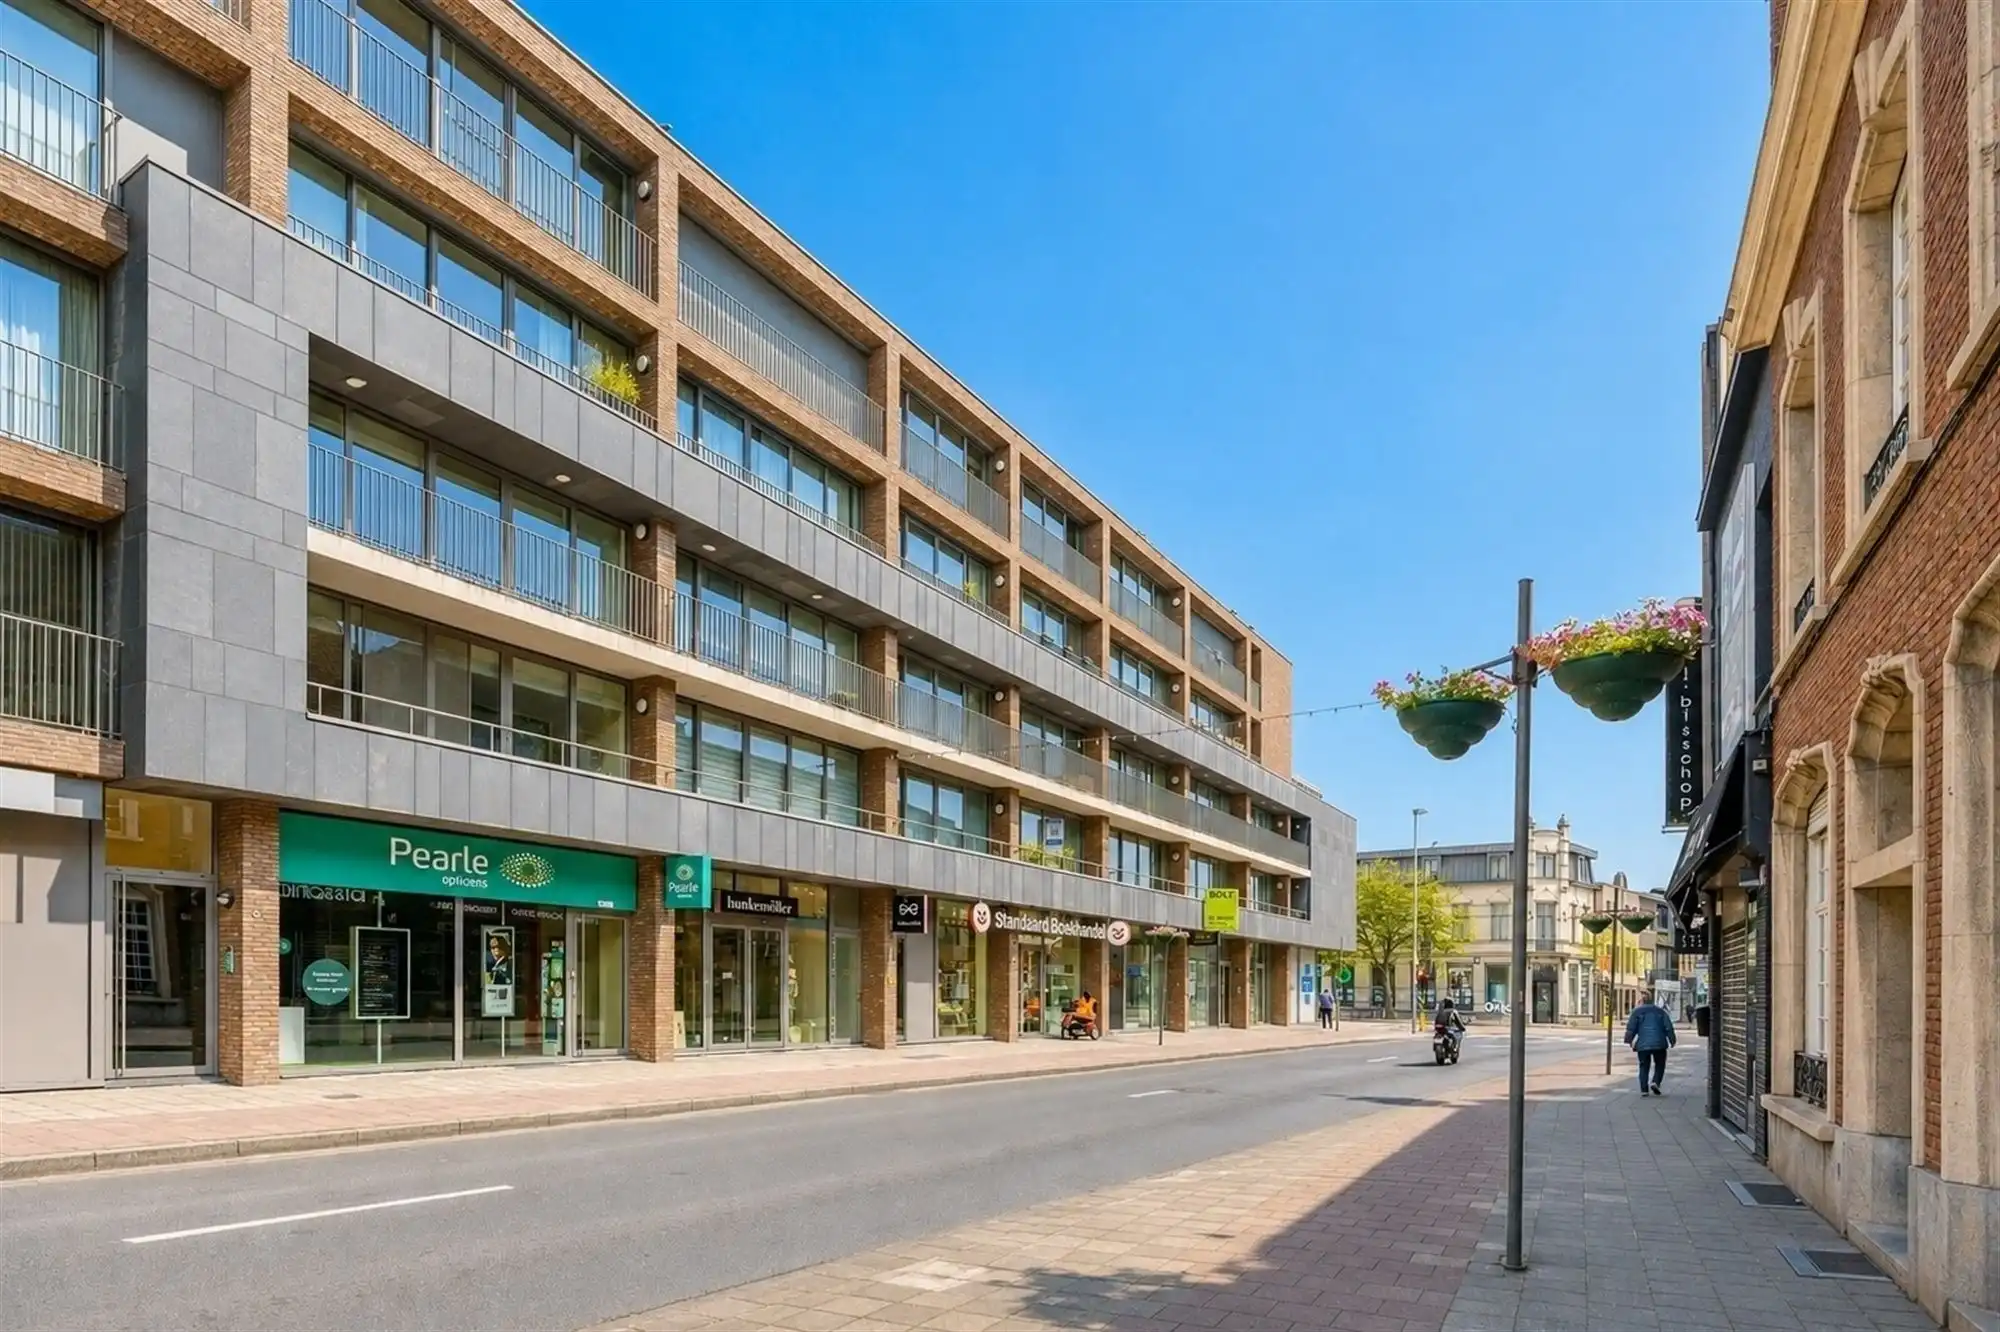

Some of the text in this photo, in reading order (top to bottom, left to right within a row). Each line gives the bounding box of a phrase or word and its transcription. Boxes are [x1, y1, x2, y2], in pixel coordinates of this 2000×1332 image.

[390, 837, 489, 875] Pearle
[1208, 890, 1235, 899] BOLT
[995, 911, 1050, 933] Standaard
